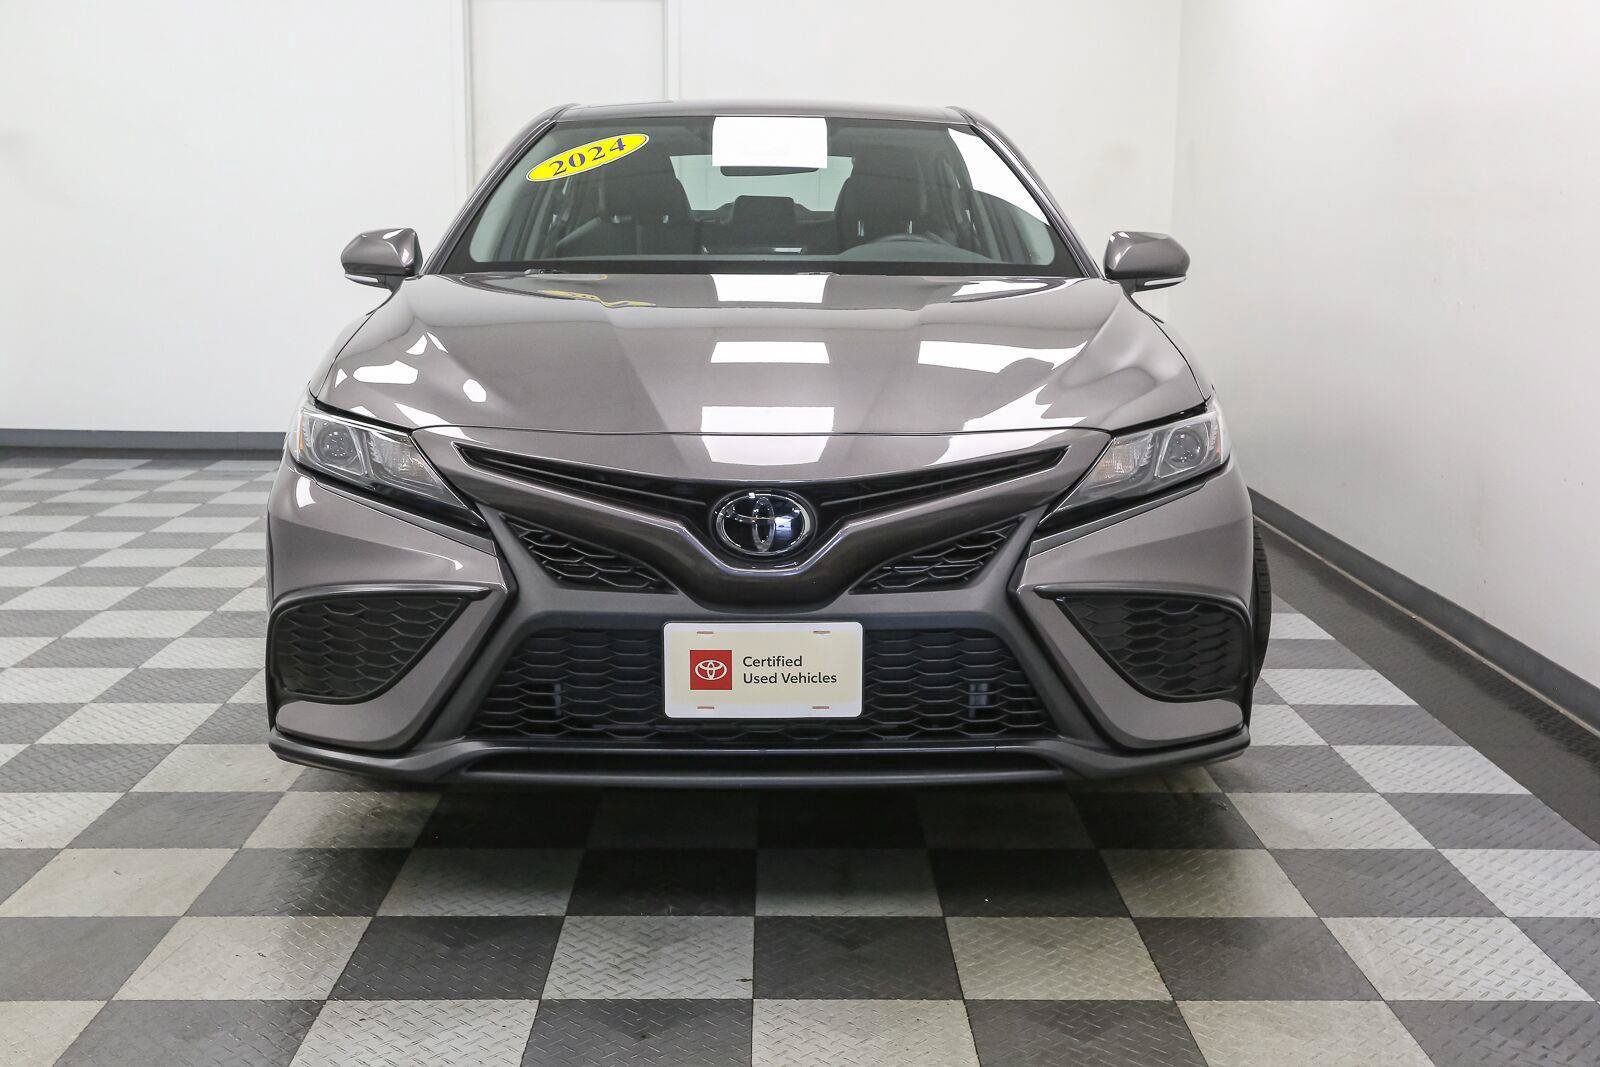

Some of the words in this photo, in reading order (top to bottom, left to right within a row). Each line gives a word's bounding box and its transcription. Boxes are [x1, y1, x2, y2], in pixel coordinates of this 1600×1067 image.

[548, 137, 626, 176] 2024
[742, 655, 803, 667] Certified
[743, 672, 777, 684] Used
[781, 671, 838, 684] Vehicles
